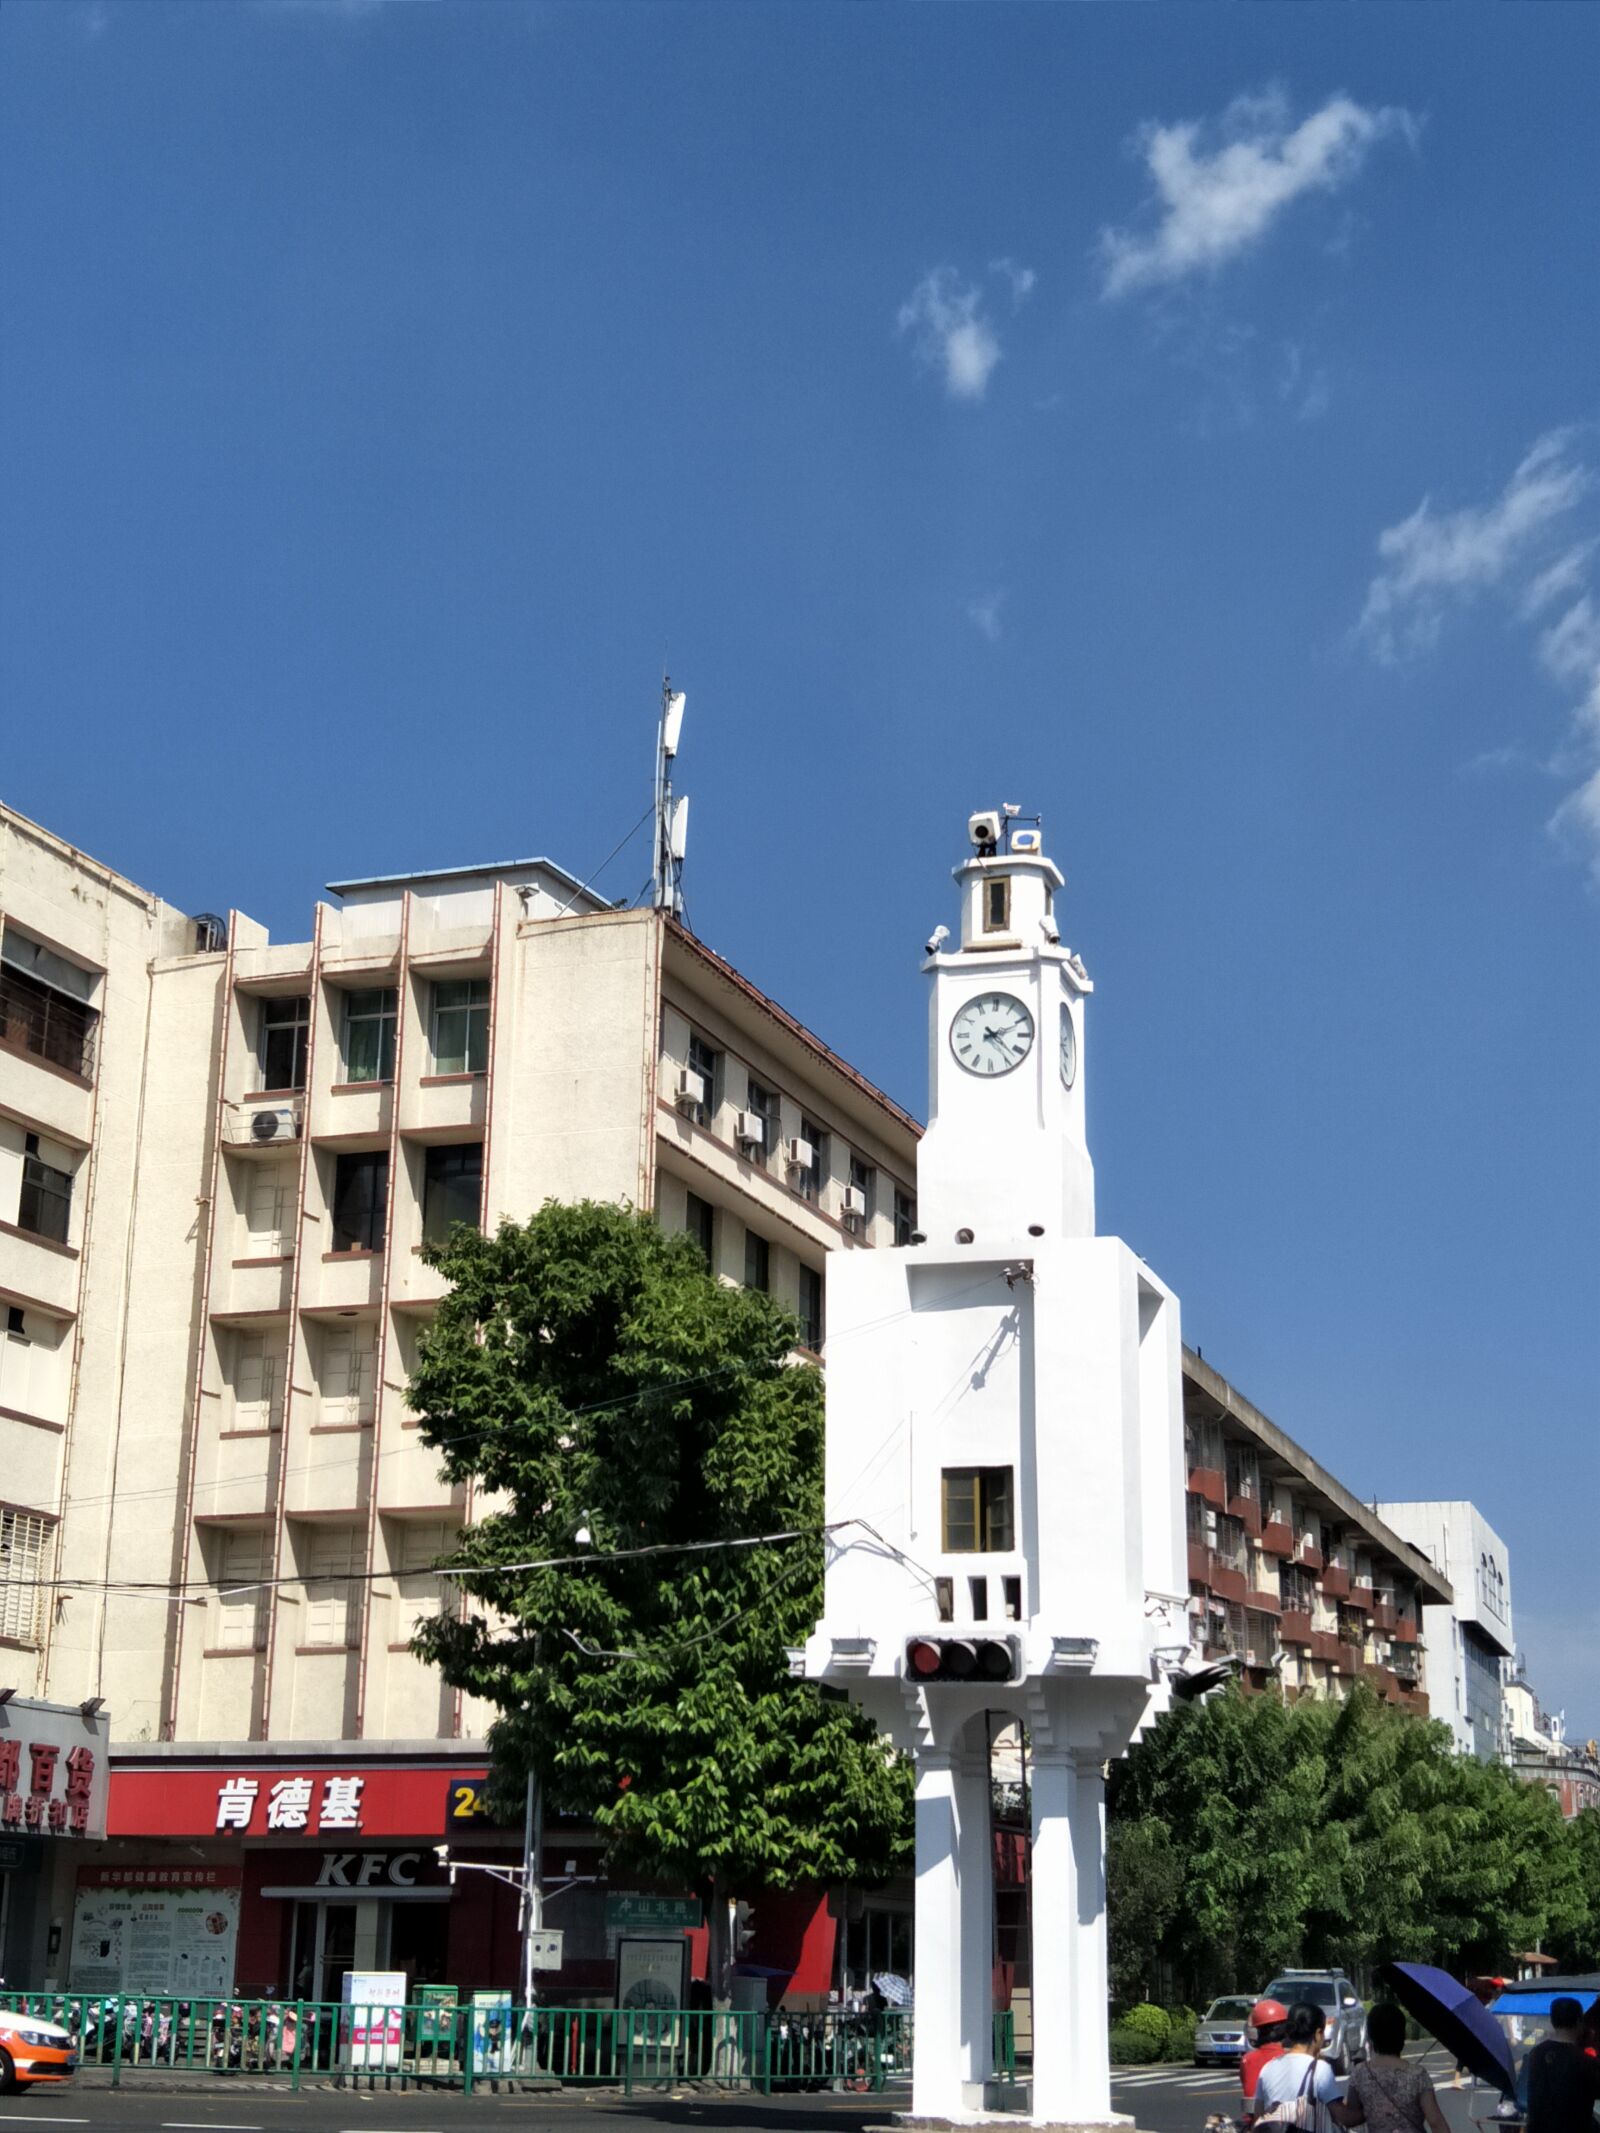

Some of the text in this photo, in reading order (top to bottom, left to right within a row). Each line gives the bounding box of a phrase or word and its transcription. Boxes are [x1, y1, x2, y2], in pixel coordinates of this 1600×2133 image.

[216, 1777, 364, 1828] 肯德基
[315, 1853, 421, 1886] KFC
[620, 1898, 686, 1913] 中山北路
